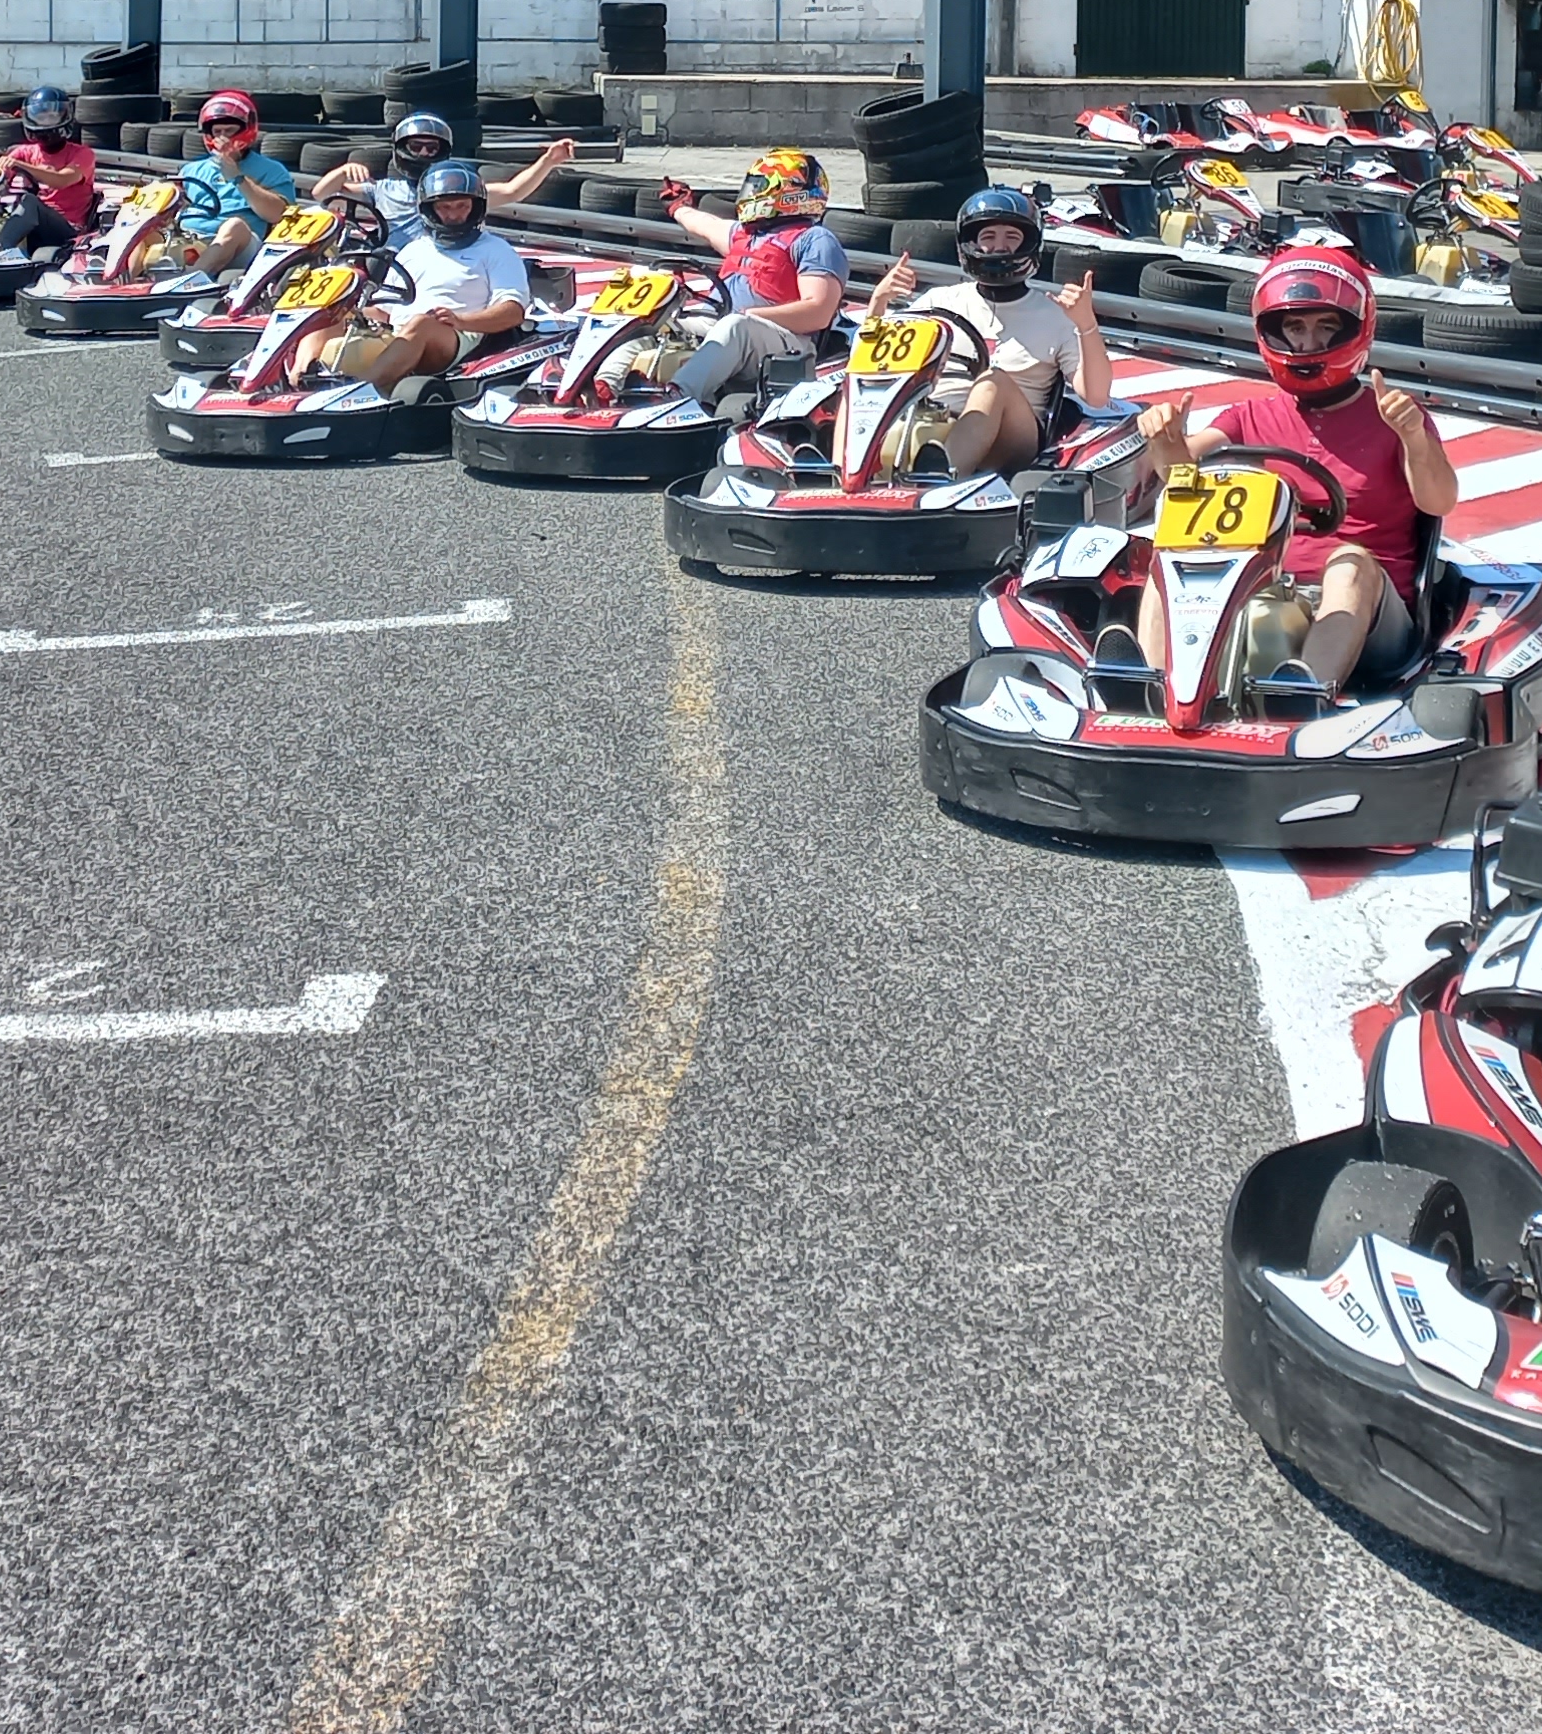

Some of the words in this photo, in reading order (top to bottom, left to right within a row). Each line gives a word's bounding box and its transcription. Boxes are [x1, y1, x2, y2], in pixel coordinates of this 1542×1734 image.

[134, 190, 161, 210] 92
[288, 276, 334, 303] 88
[605, 282, 653, 309] 79
[870, 328, 916, 363] 68
[1182, 485, 1249, 537] 78
